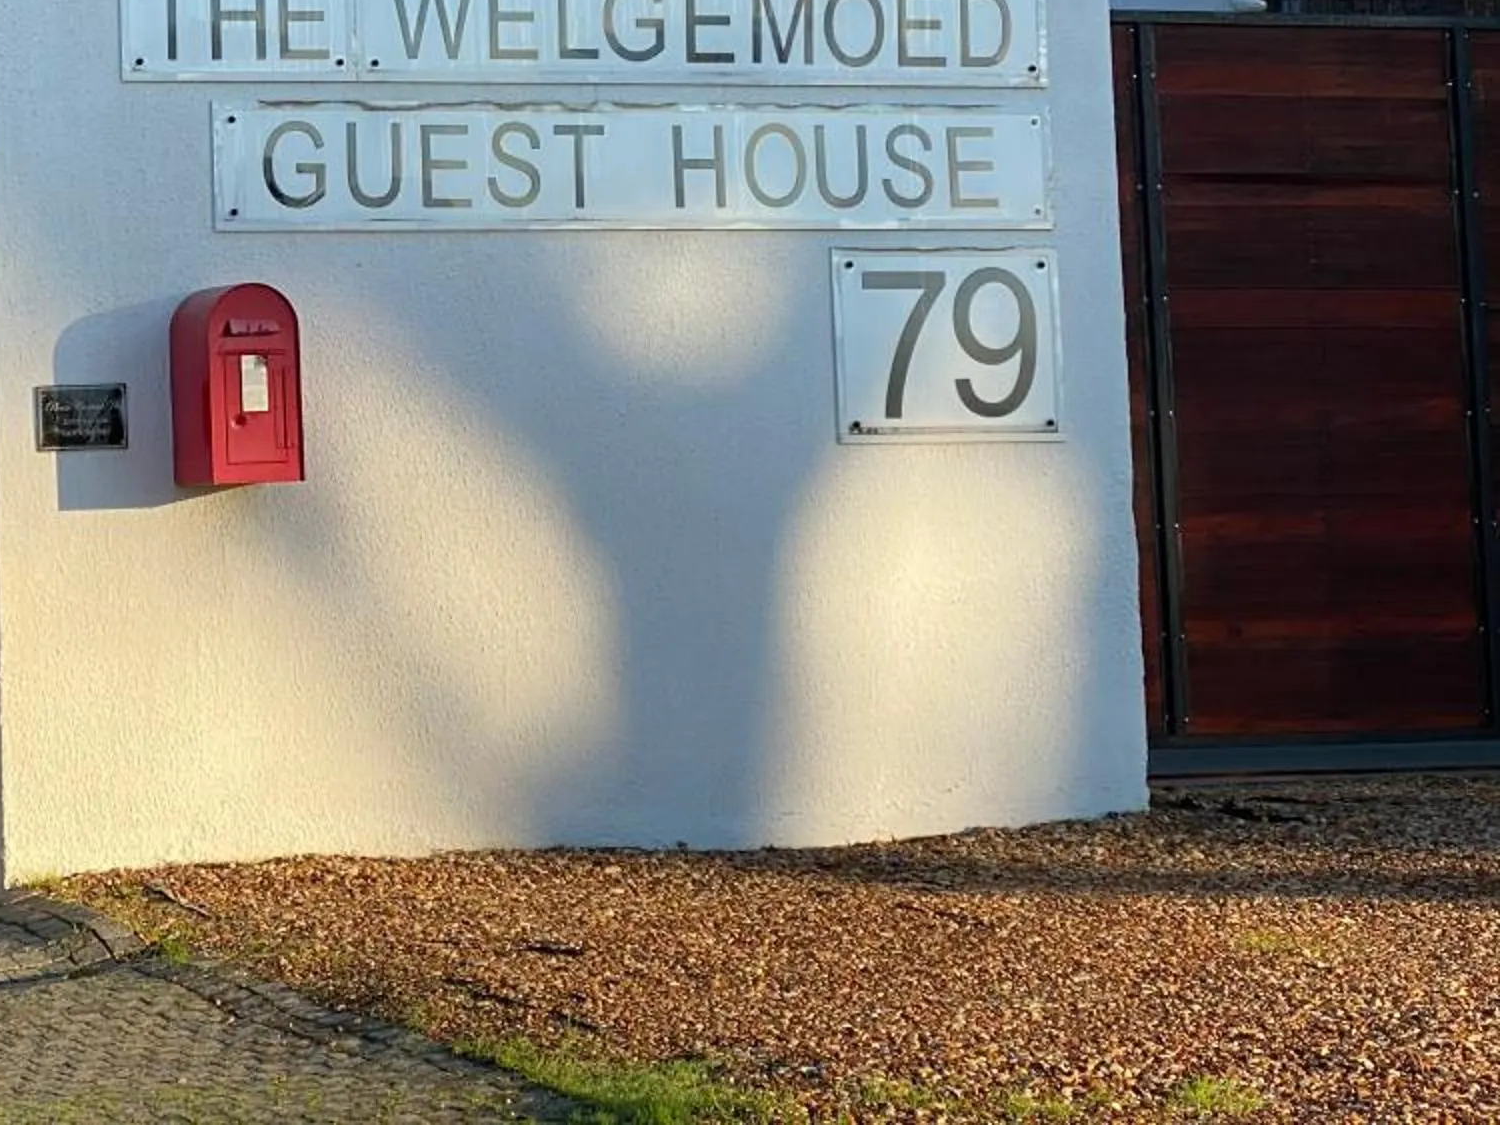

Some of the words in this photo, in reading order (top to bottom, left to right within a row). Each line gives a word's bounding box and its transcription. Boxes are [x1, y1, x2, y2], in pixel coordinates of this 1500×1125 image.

[261, 120, 606, 210] GUEST
[672, 121, 1001, 210] HOUSE
[861, 265, 1038, 420] 79
